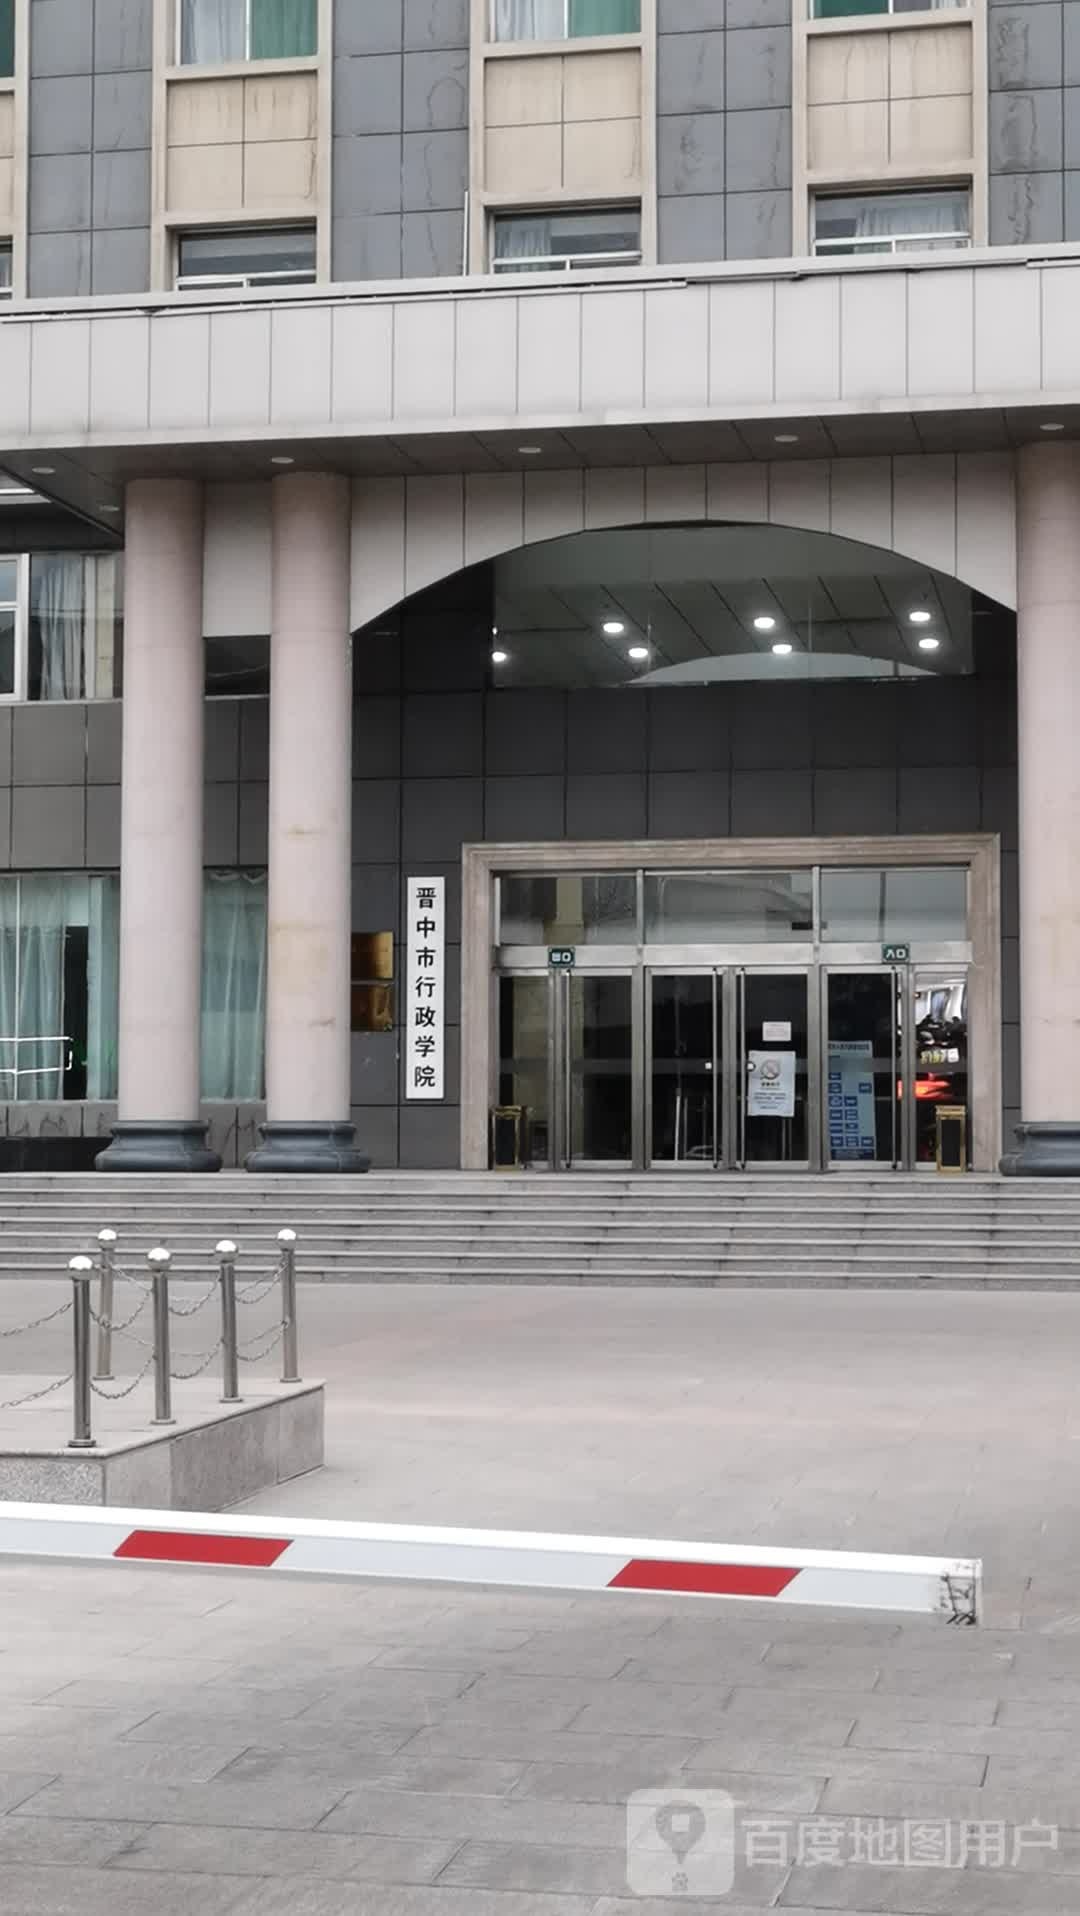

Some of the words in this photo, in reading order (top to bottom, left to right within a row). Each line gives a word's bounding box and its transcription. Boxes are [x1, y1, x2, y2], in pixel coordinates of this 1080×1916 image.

[414, 887, 436, 1088] 晋中市行政学院
[886, 948, 906, 959] 入口
